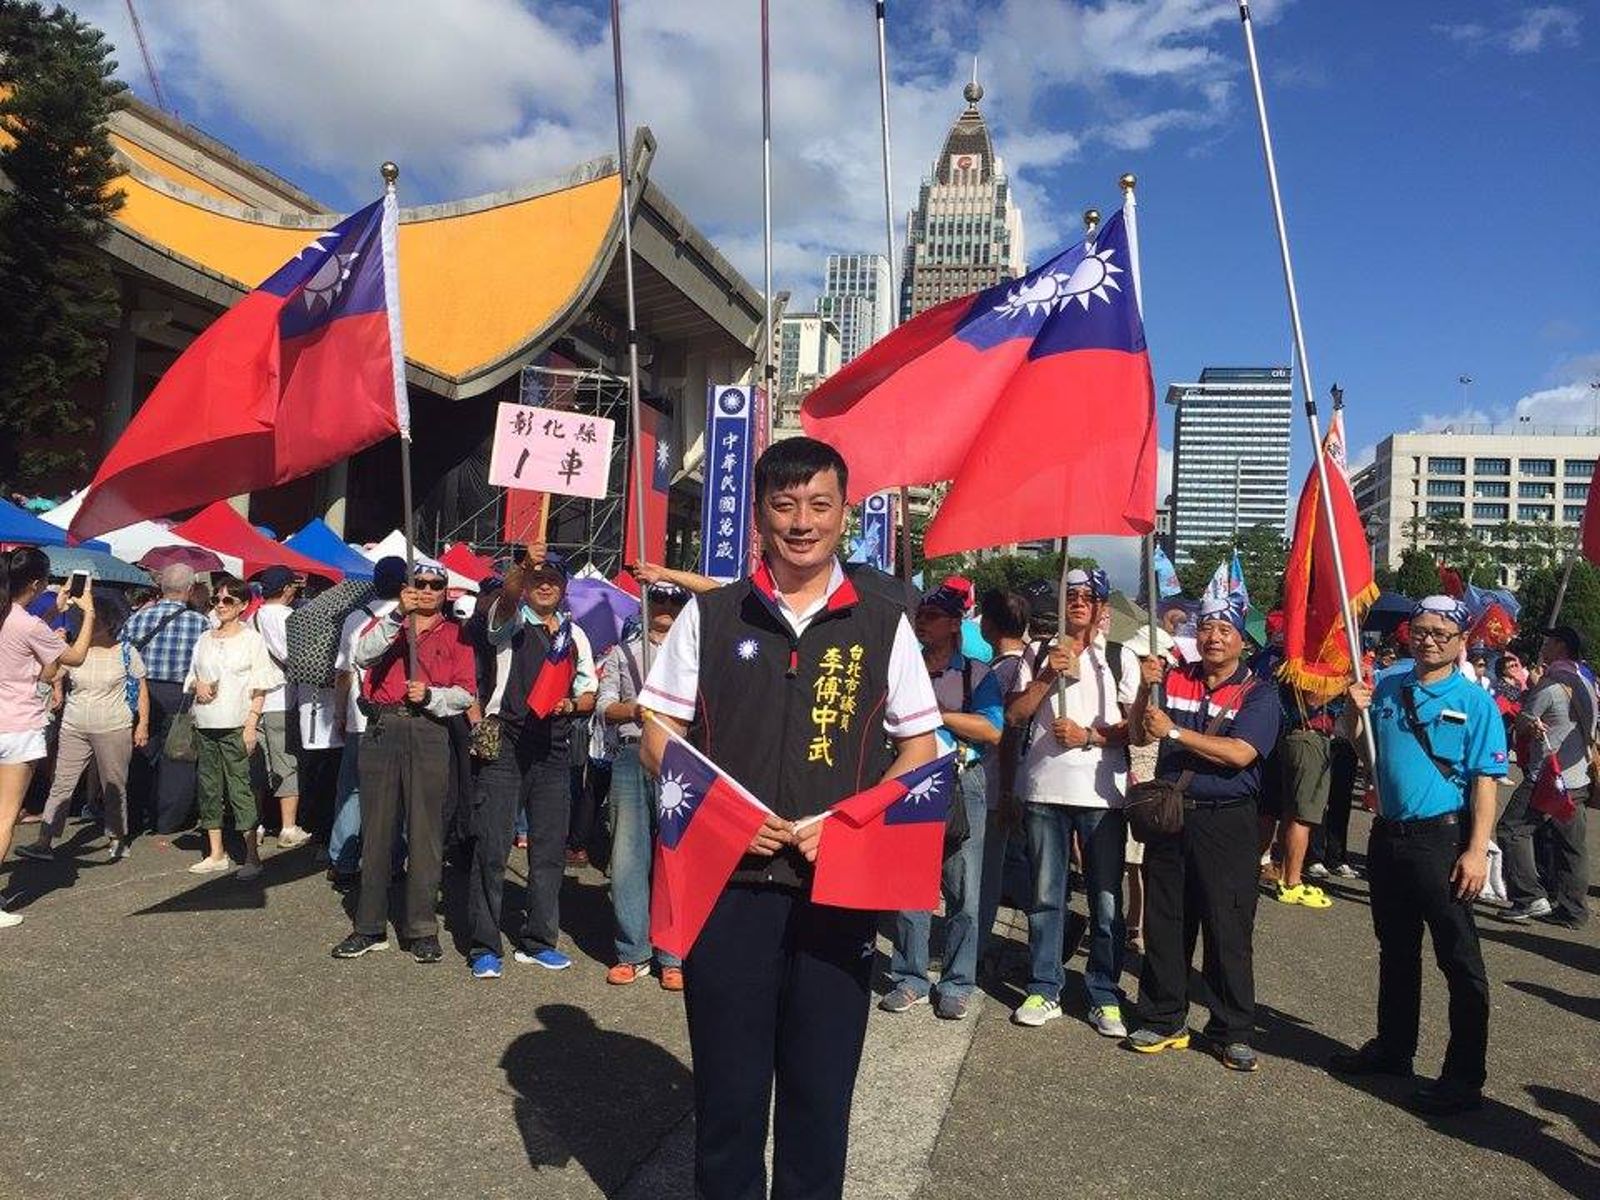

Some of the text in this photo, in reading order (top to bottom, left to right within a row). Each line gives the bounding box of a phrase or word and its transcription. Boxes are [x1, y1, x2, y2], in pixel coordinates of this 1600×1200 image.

[509, 410, 597, 443] 彰化縣
[715, 432, 739, 560] 中華民國萬歲
